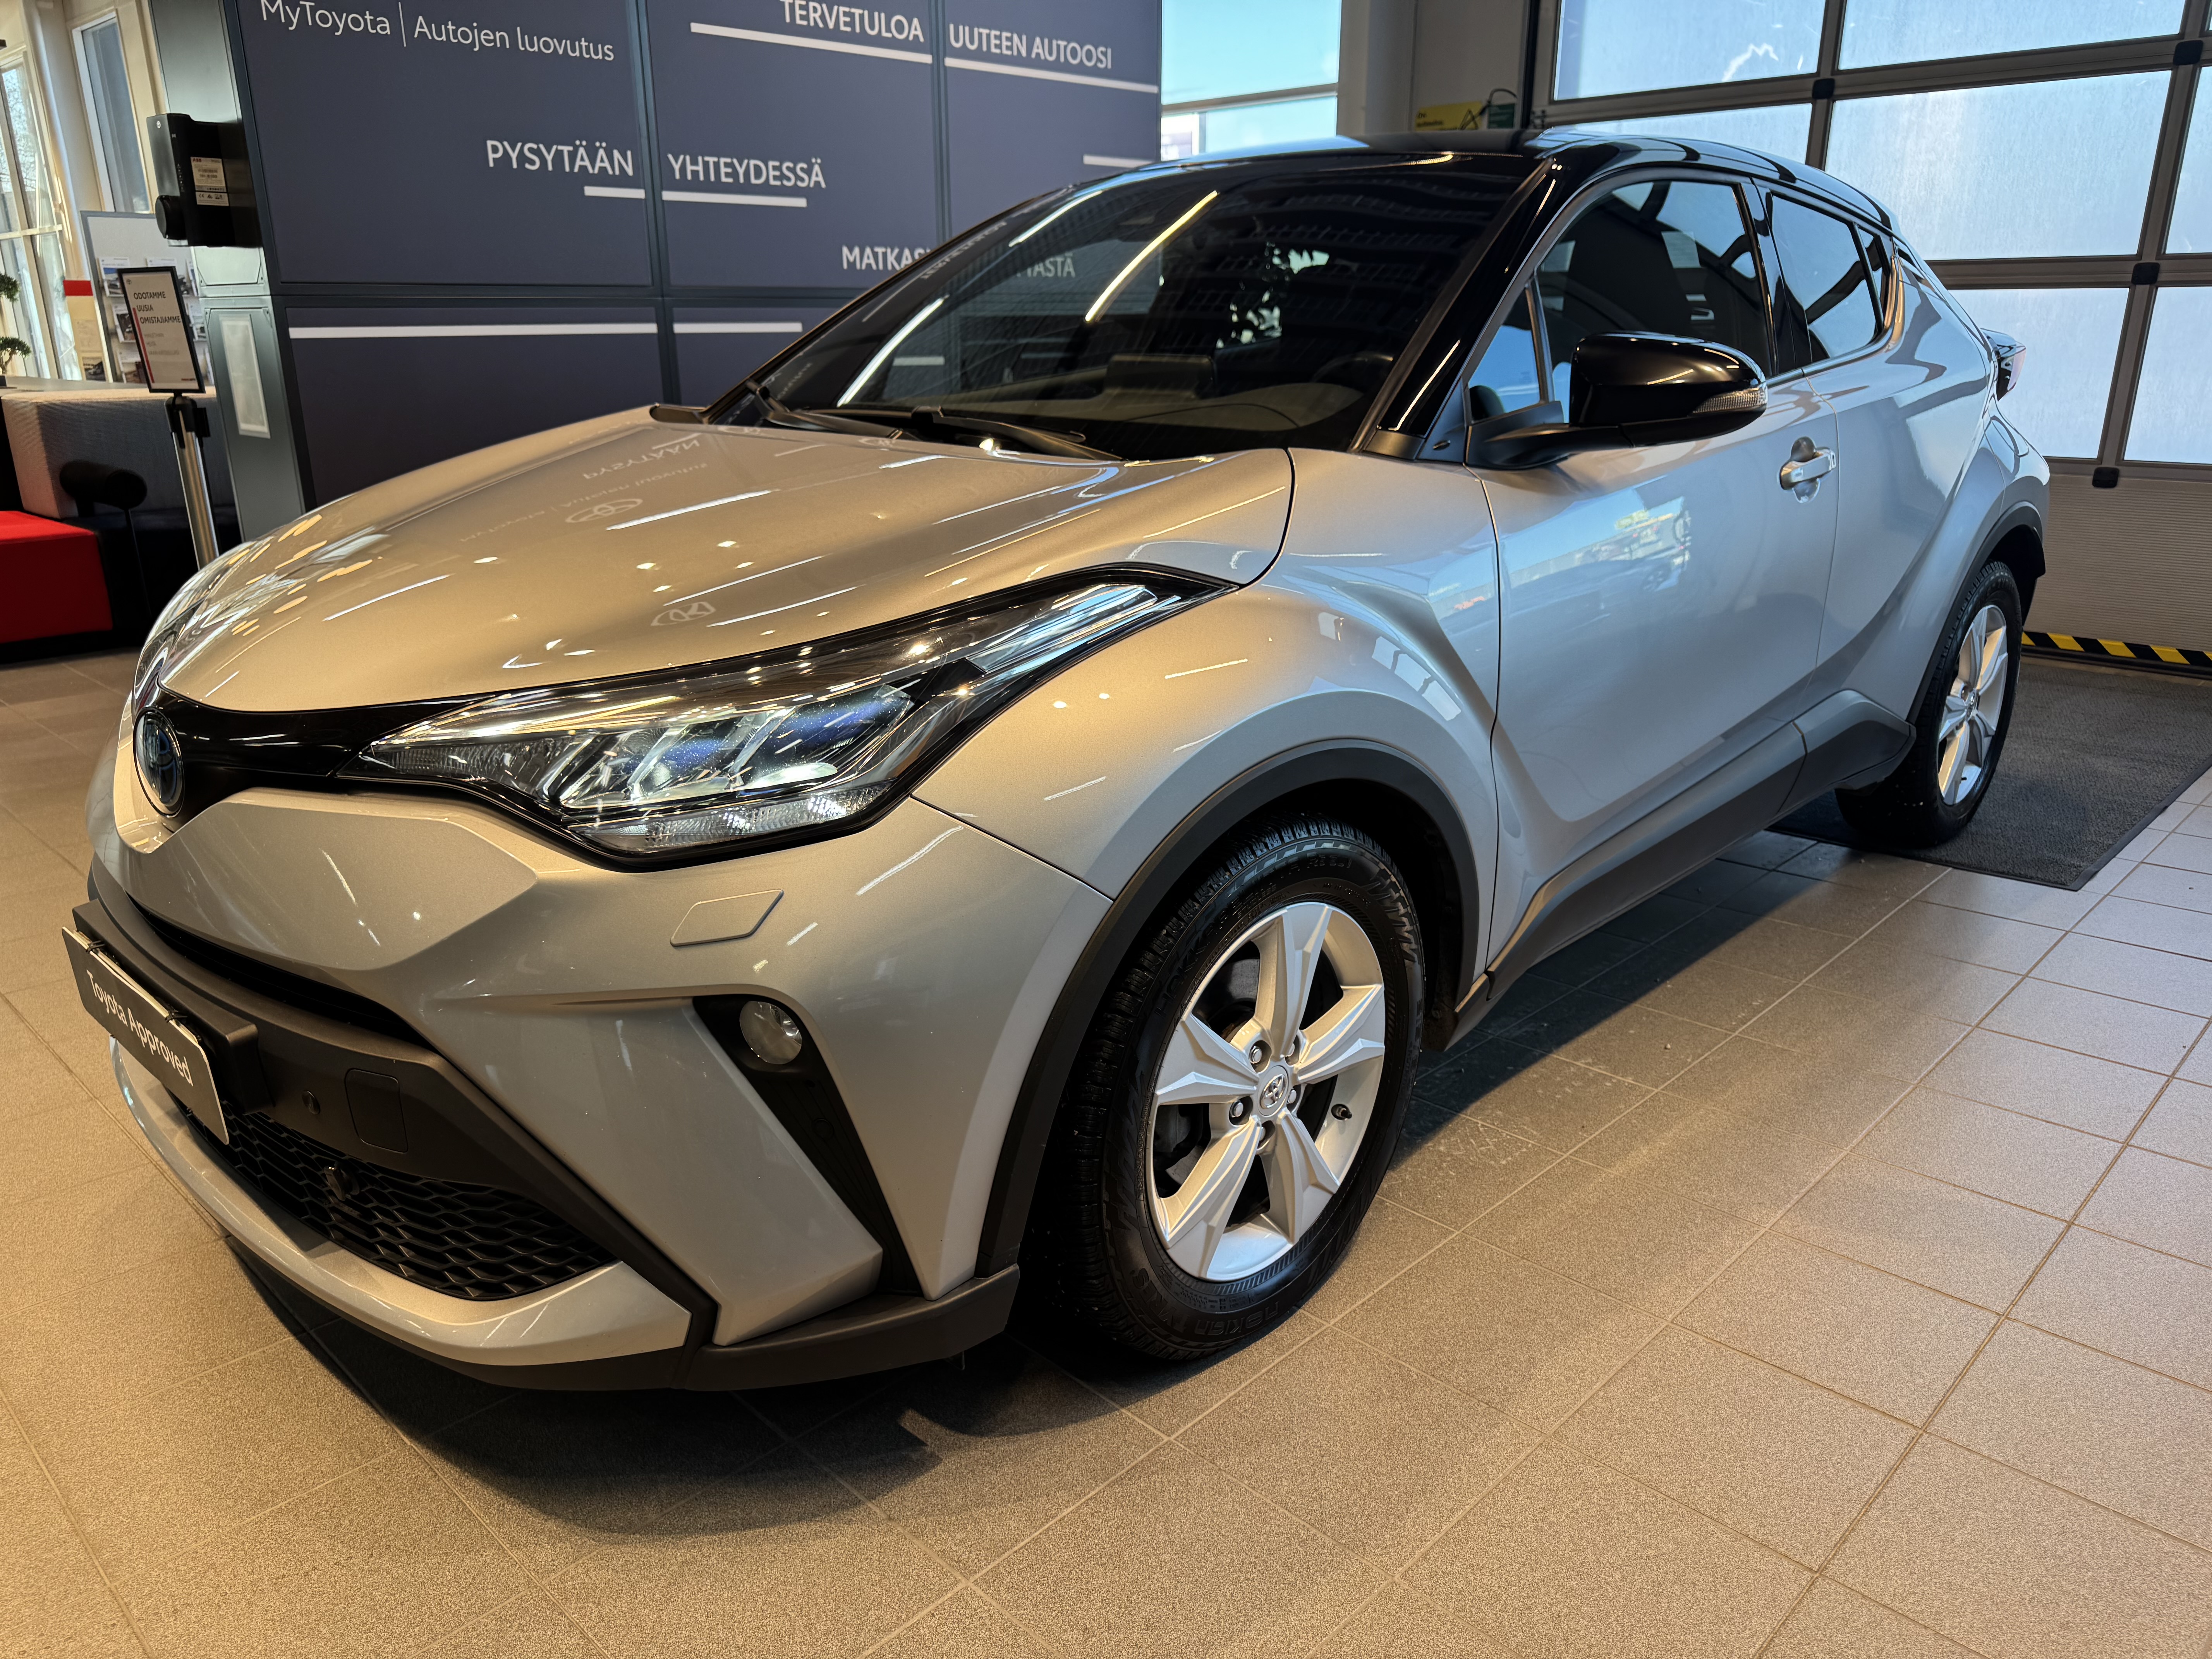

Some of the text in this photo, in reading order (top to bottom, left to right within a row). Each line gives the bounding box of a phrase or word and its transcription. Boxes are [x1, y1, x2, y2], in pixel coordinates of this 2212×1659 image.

[261, 0, 614, 61] MyToyota Autojen luovutus
[780, 0, 1112, 70] TERVETULOA UUTEEN AUTOOSI
[486, 140, 826, 189] PYSYTÄÄN YHTEYDESSÄ
[134, 291, 166, 300] ODOTAMME
[140, 316, 181, 324] OMISTAJIAMME
[87, 969, 193, 1087] Toyota Approved
